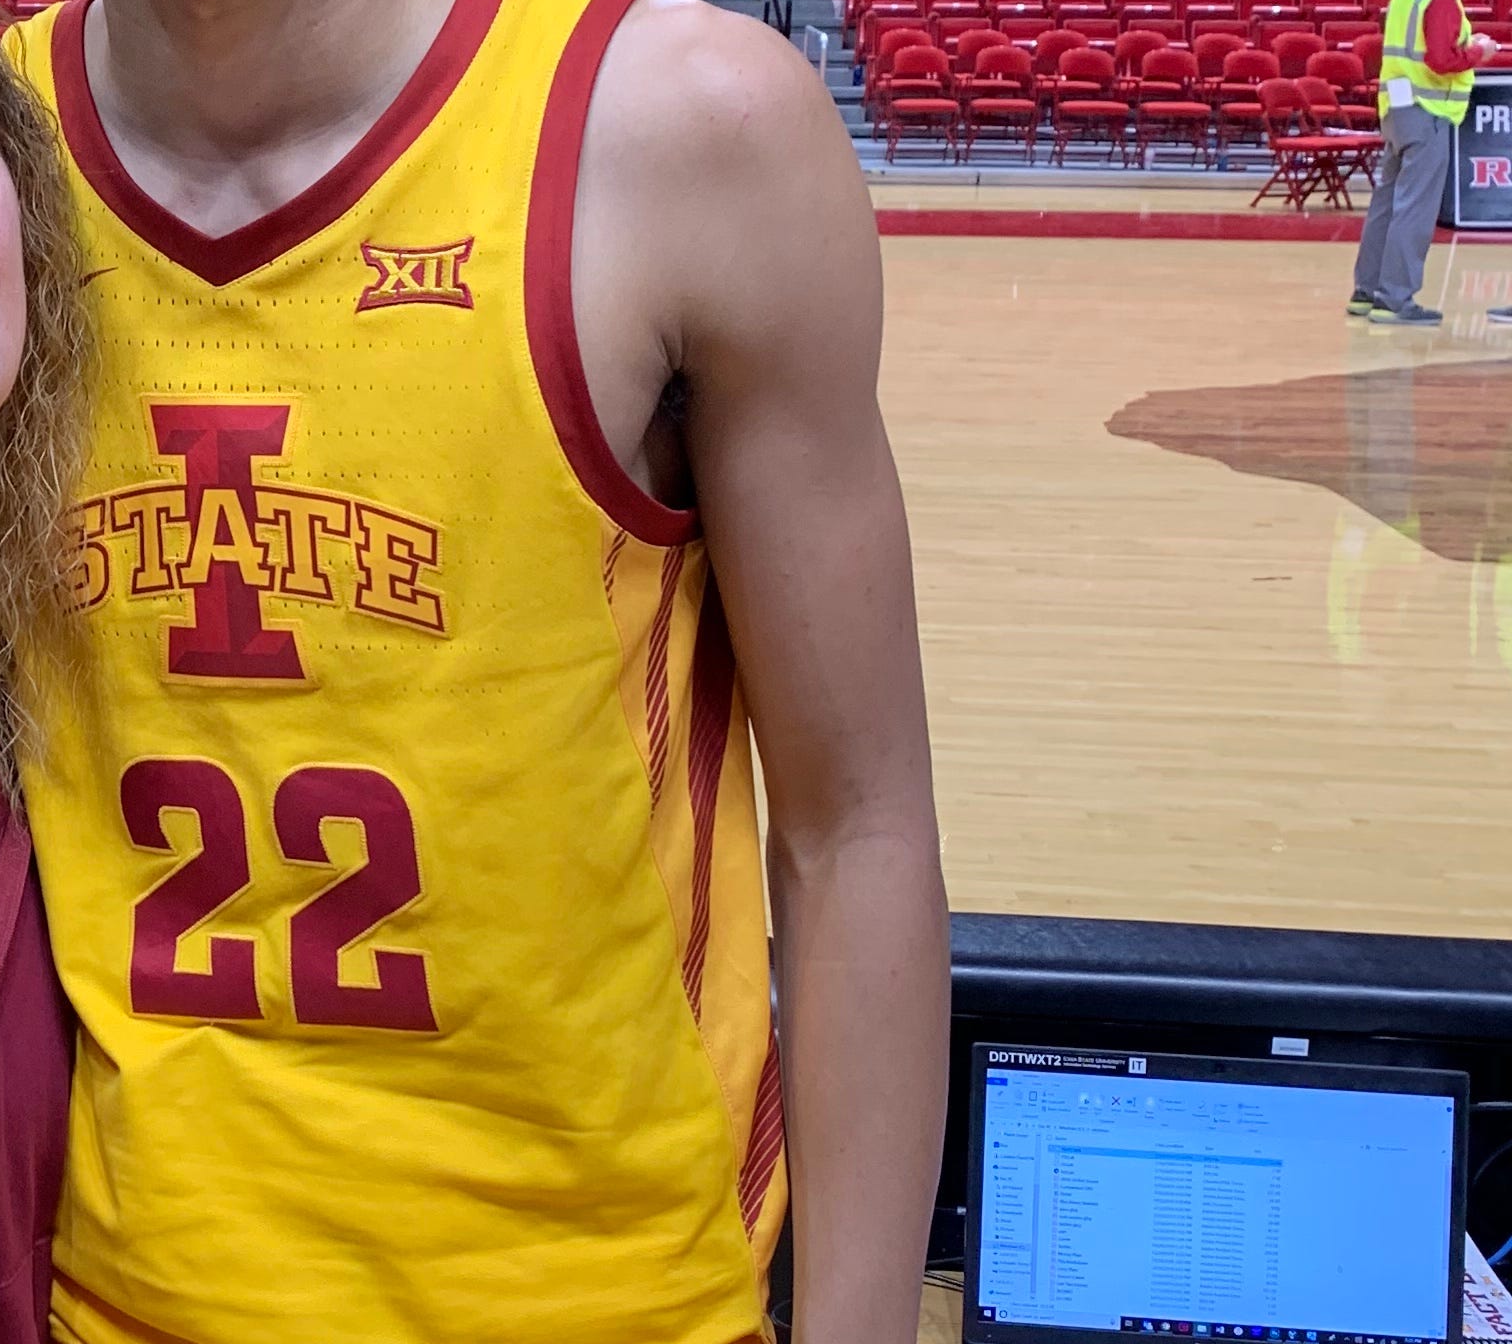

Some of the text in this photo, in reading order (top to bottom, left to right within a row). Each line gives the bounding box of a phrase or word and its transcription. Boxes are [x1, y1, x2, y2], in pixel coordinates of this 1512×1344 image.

[366, 247, 468, 301] XII
[57, 482, 452, 637] STATE
[118, 754, 441, 1036] 22
[988, 1050, 1062, 1067] DDTTWXT2
